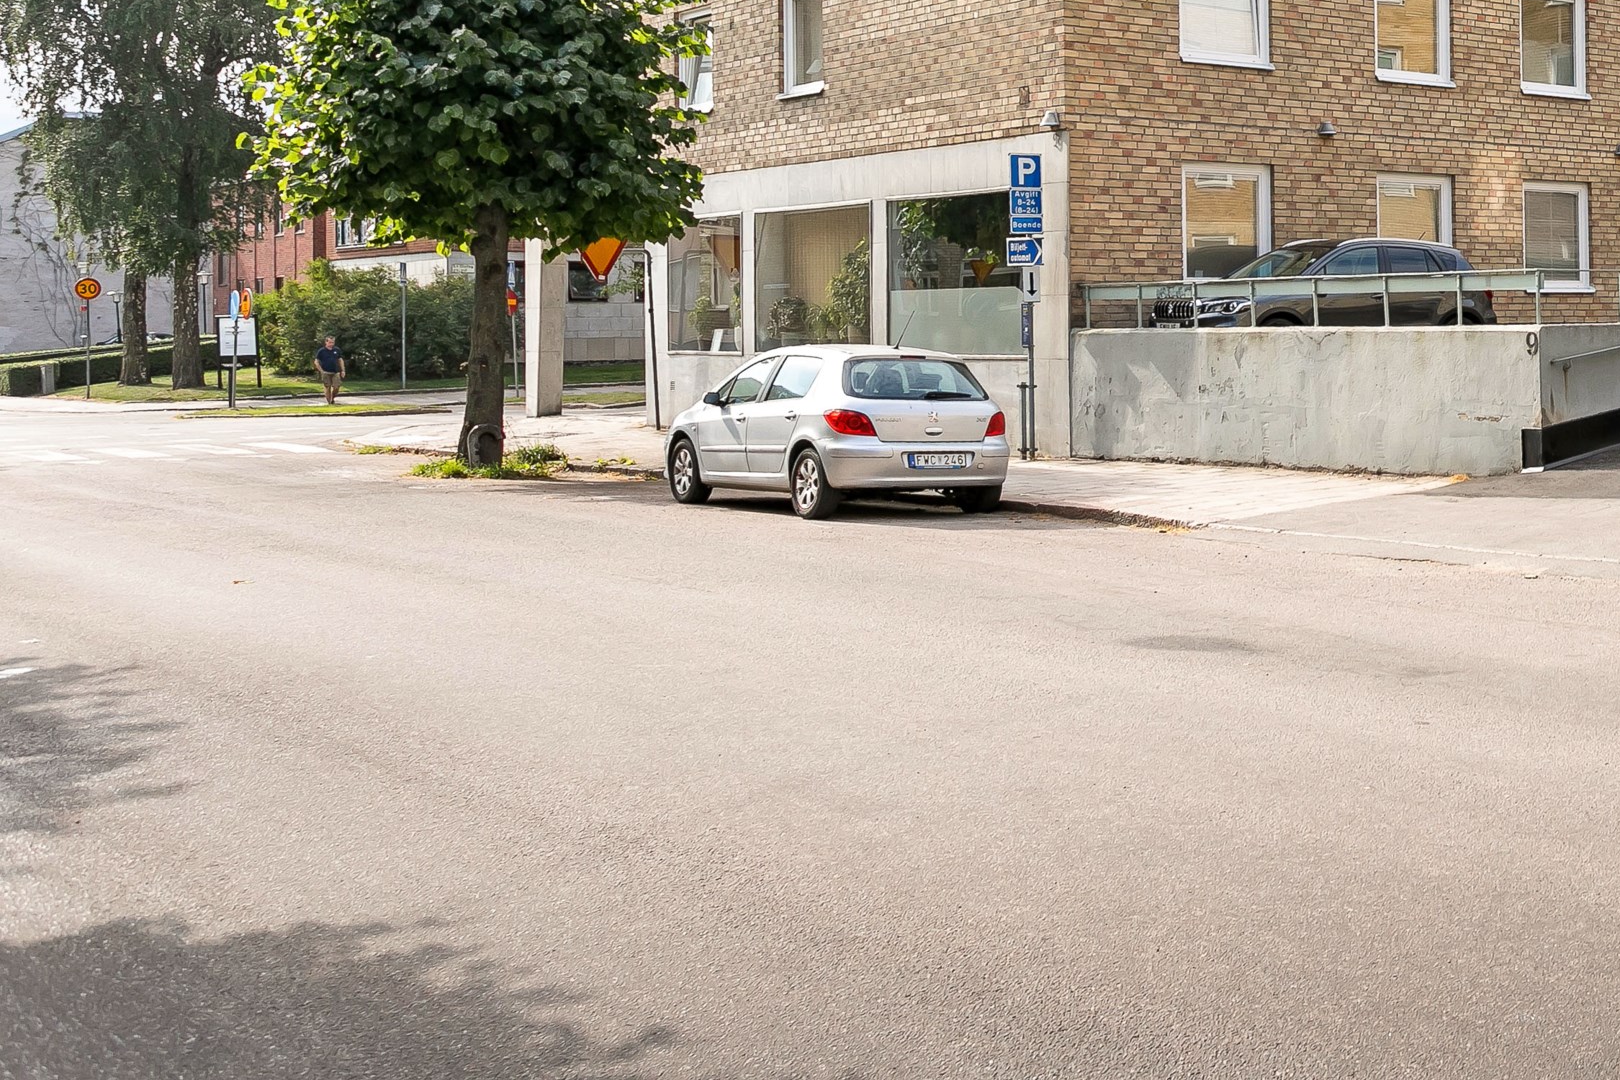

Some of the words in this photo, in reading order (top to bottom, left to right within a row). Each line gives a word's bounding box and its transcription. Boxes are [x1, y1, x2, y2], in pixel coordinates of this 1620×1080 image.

[1018, 157, 1036, 185] P
[1014, 191, 1038, 199] Avgift
[1014, 206, 1039, 214] (8-24)
[1012, 221, 1042, 229] Boende
[1010, 242, 1028, 253] Biljett-
[1010, 254, 1031, 262] automat
[79, 283, 97, 295] 30
[1526, 331, 1538, 356] 9
[916, 455, 937, 465] FWC
[944, 454, 963, 465] 246
